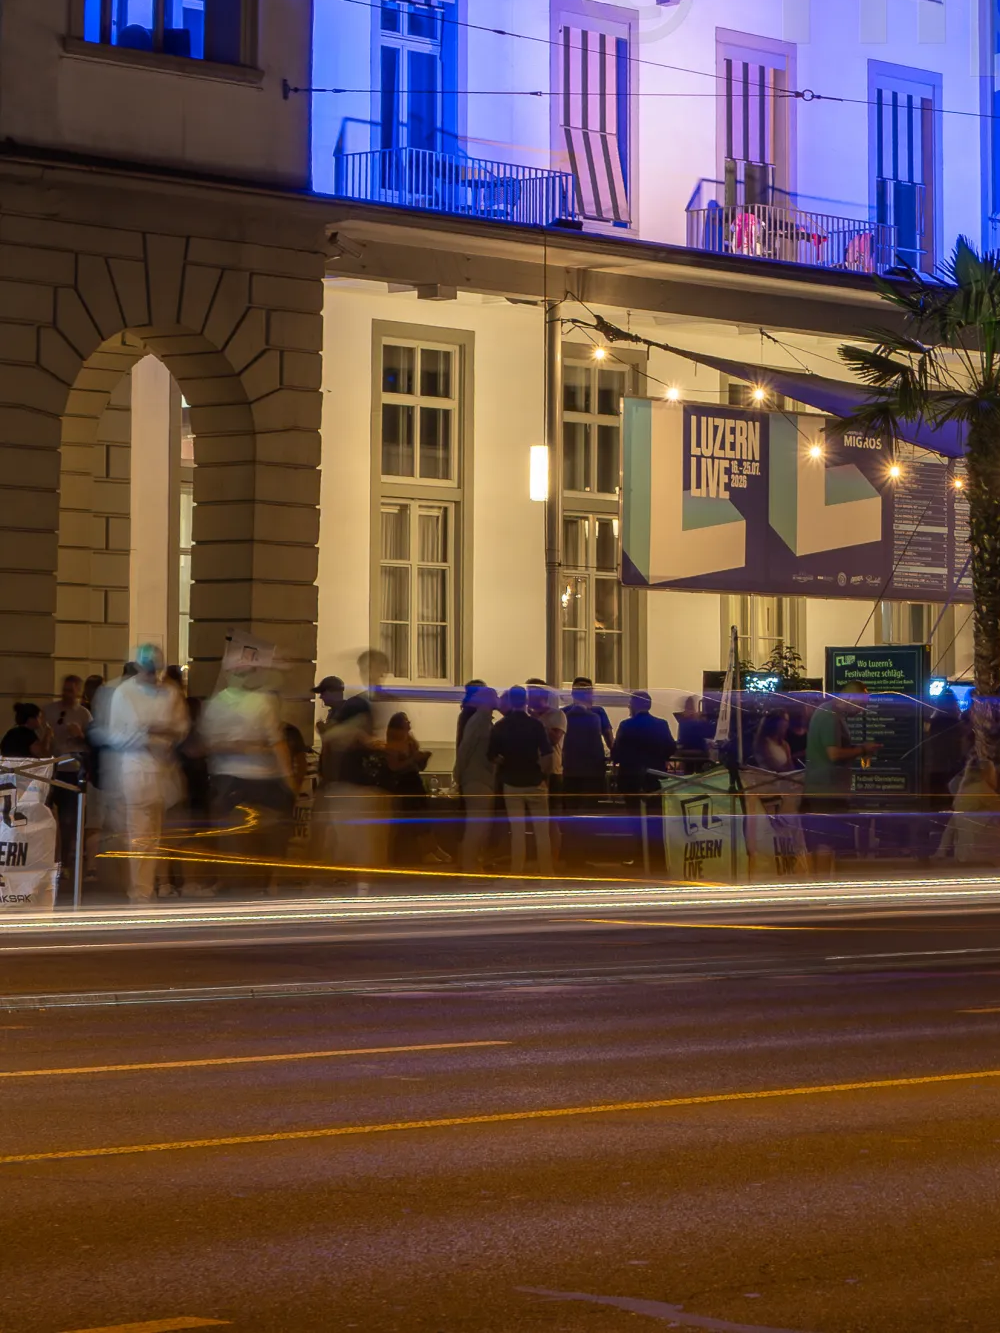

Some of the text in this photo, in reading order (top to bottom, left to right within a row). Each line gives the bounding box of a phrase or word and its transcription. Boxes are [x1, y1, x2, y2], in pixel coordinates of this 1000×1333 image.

[691, 415, 760, 460] LUZERN
[844, 435, 882, 449] MIGROS
[691, 457, 730, 499] LIVE
[731, 474, 747, 488] 2026
[684, 839, 722, 862] LUZERN
[683, 860, 704, 881] LIVE
